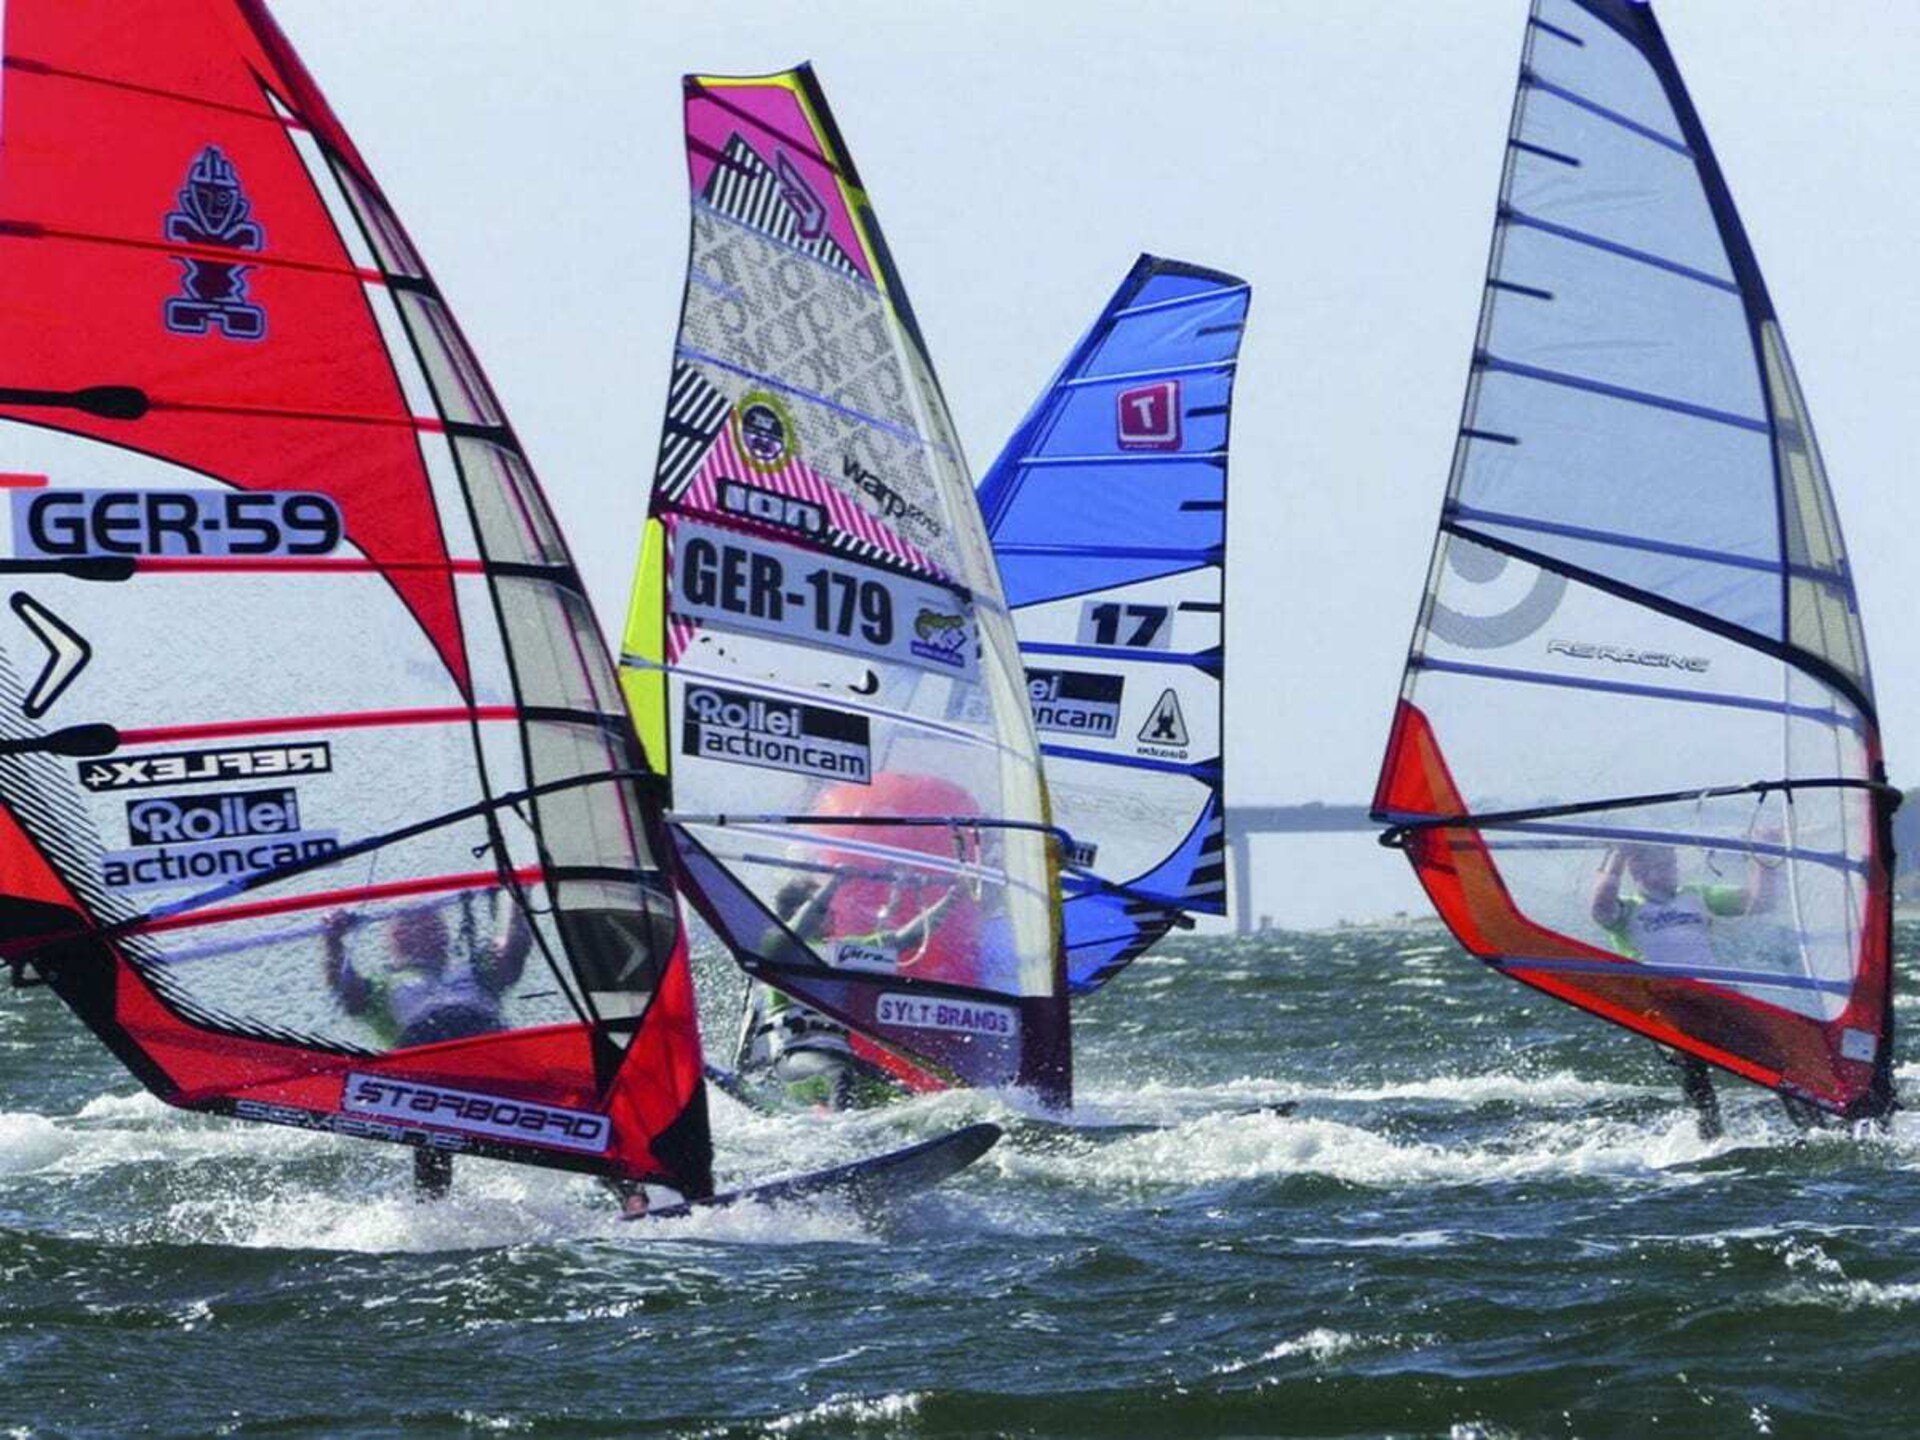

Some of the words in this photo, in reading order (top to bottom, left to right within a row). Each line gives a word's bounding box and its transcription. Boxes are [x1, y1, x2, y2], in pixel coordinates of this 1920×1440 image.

[27, 492, 343, 555] GER-59
[682, 536, 893, 646] GER-179
[1090, 602, 1169, 648] 17
[687, 688, 801, 738] Rollei
[705, 729, 865, 776] actioncam
[129, 791, 299, 843] Rollei
[103, 836, 340, 887] actioncam
